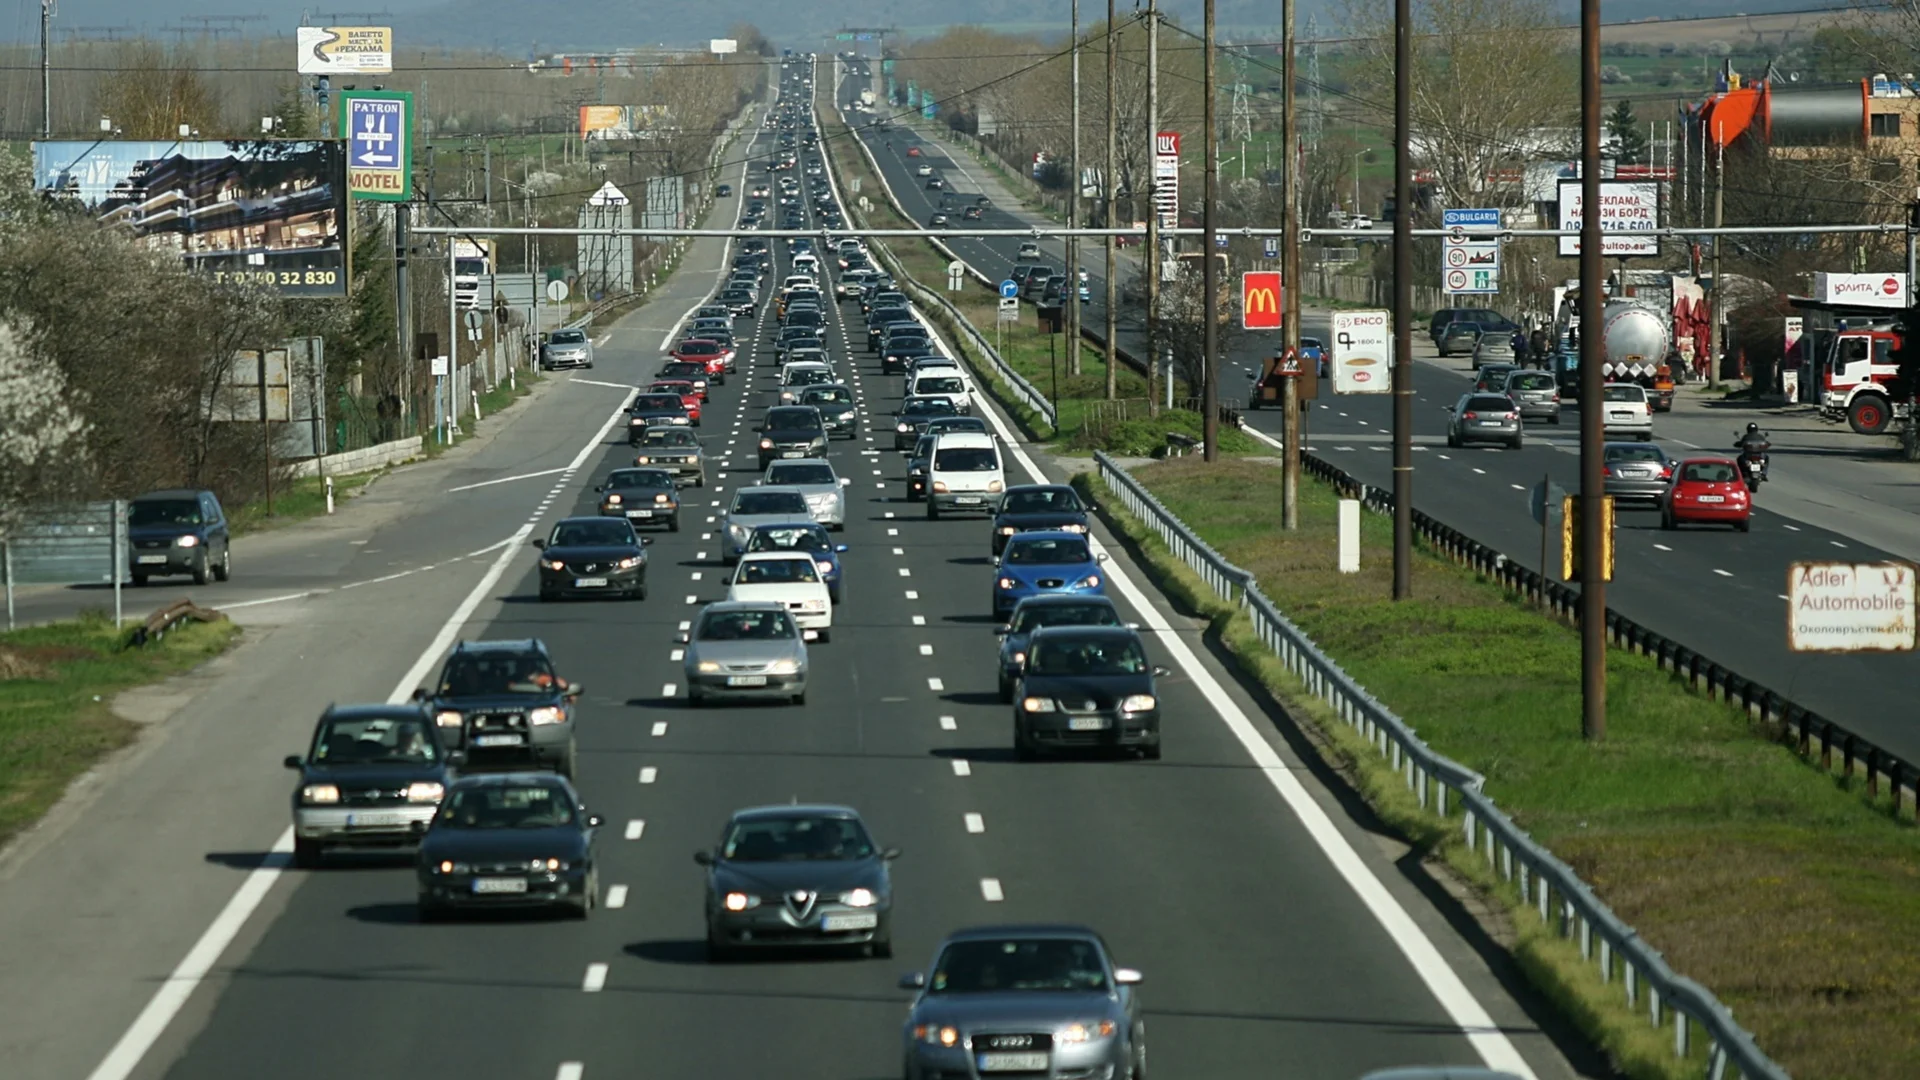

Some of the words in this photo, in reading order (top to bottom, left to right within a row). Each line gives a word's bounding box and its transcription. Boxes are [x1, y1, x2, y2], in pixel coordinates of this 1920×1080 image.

[354, 103, 398, 113] PATRON
[350, 173, 401, 189] MOTEL
[1599, 196, 1641, 205] ЕКЛАМА
[1460, 212, 1497, 221] BULGARIA
[1619, 208, 1648, 218] БОРД
[1452, 253, 1463, 263] 90
[280, 271, 301, 285] 32
[305, 271, 336, 285] 830
[1451, 275, 1464, 284] 140
[1834, 283, 1873, 293] ЮЛИТА
[1354, 317, 1384, 326] ENCO
[1799, 570, 1849, 587] Adler
[1799, 593, 1906, 611] Automobile
